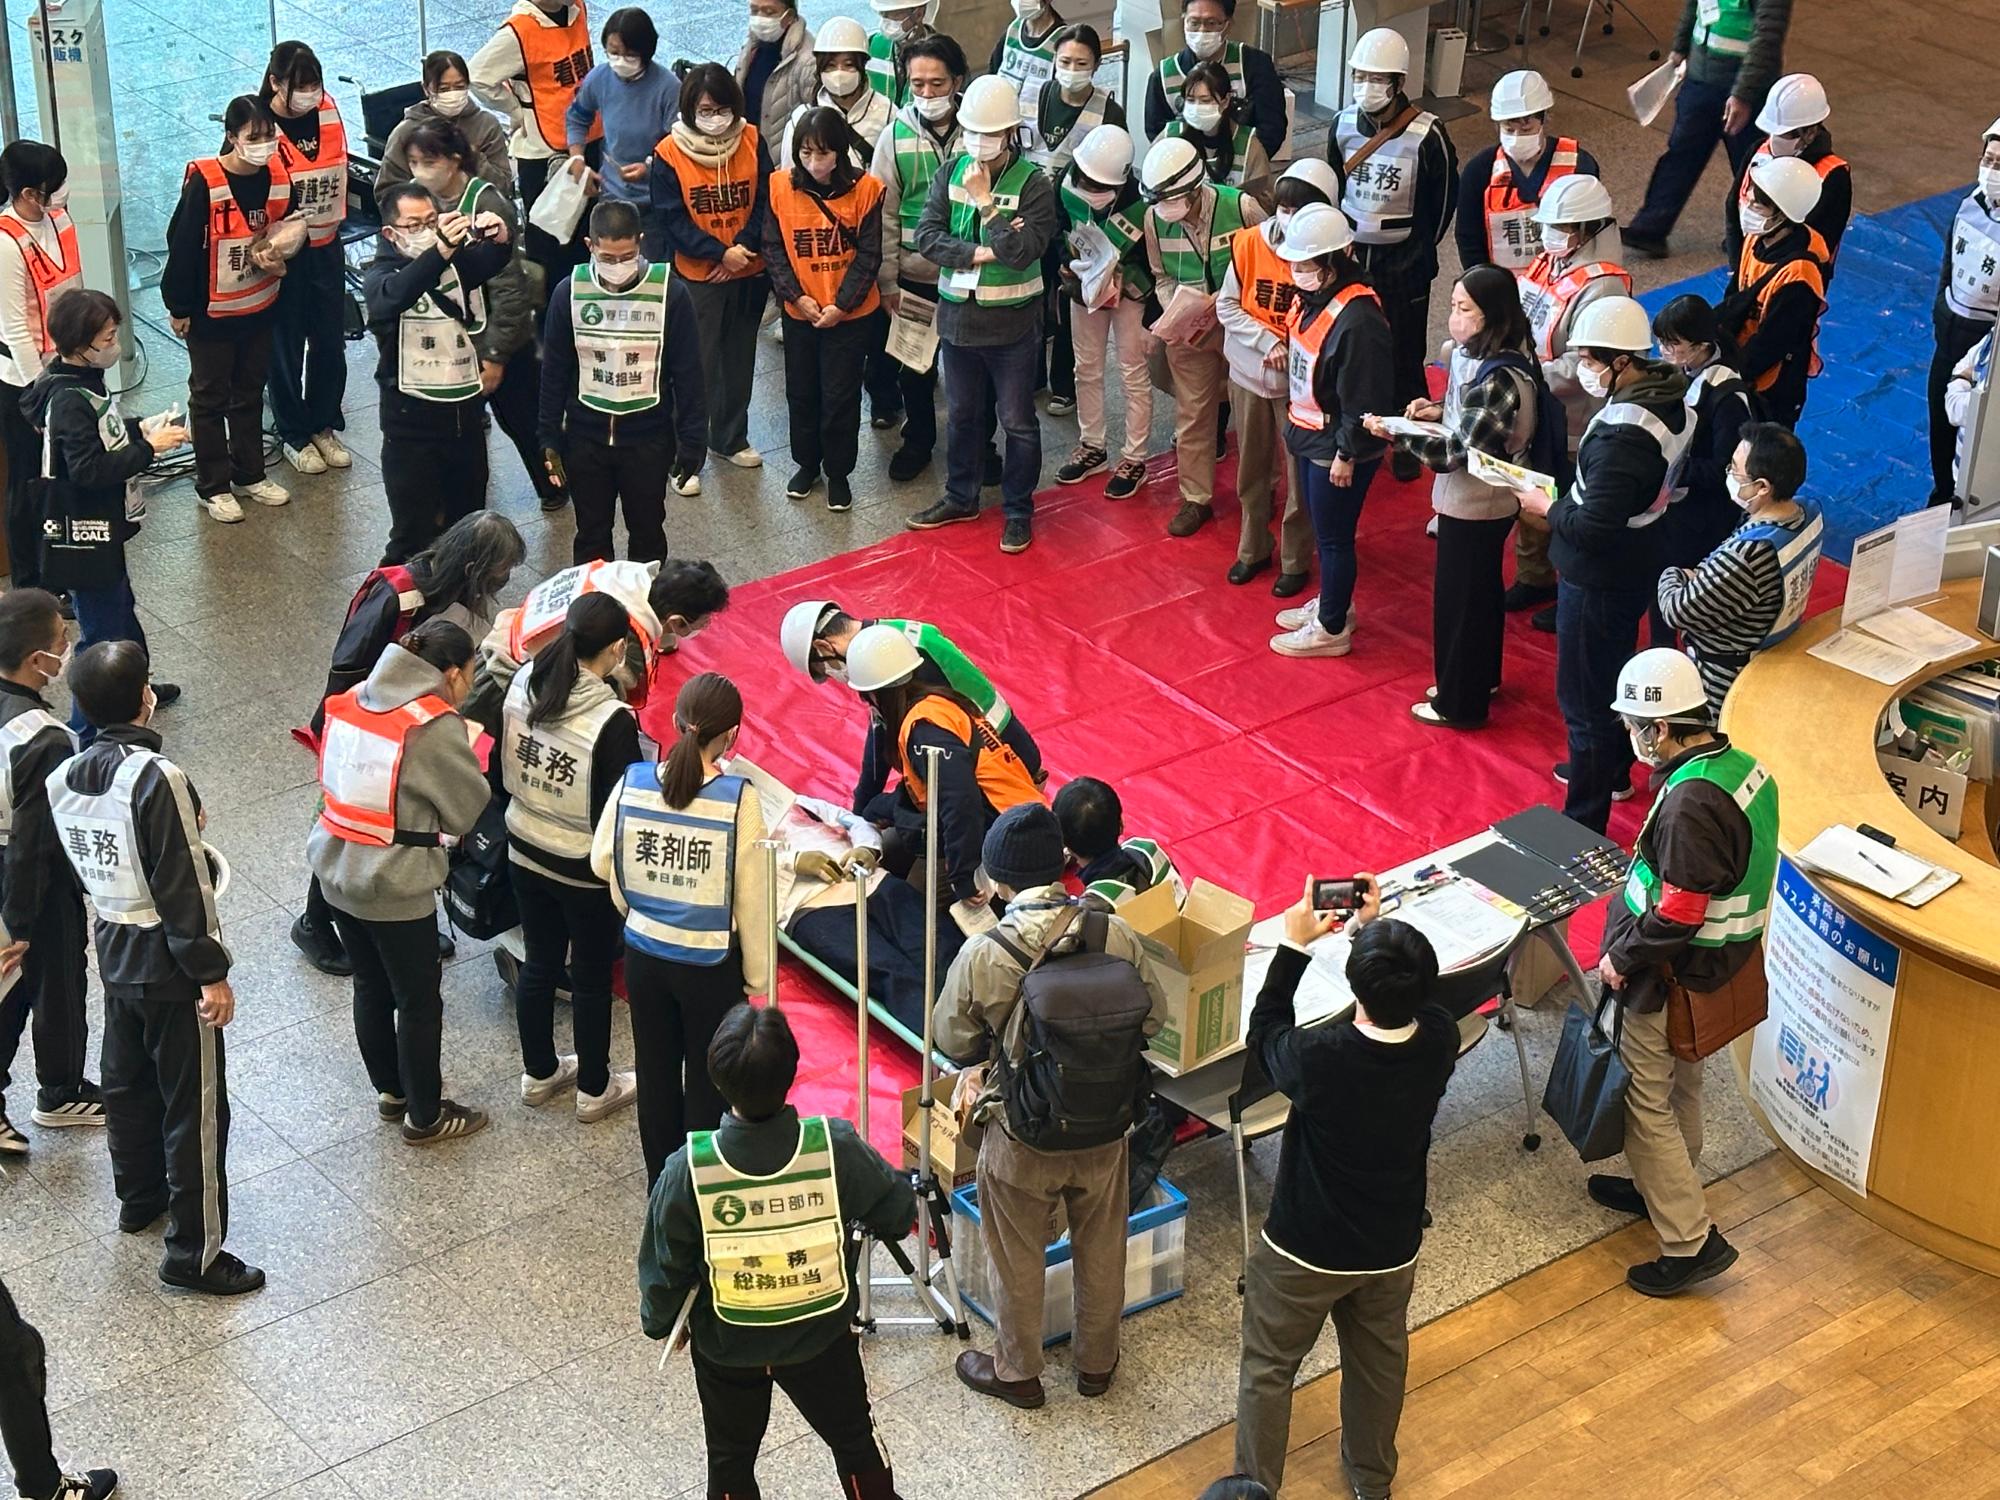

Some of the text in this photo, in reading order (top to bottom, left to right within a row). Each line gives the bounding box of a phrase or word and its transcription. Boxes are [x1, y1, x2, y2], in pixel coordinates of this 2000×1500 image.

[1350, 162, 1402, 191] 事務
[690, 180, 751, 214] 看護師
[72, 531, 111, 542] GOALS
[1624, 683, 1662, 703] 医師
[515, 733, 578, 787] 事務
[520, 771, 564, 798] 春日部市
[65, 825, 119, 867] 事務
[635, 828, 713, 874] 薬剤師
[647, 870, 698, 889] 春日部市
[1811, 892, 1847, 929] 来院時
[1782, 879, 1885, 974] マスク着用のお願い
[749, 1192, 825, 1216] 春日部市
[732, 1268, 822, 1291] 総務担当
